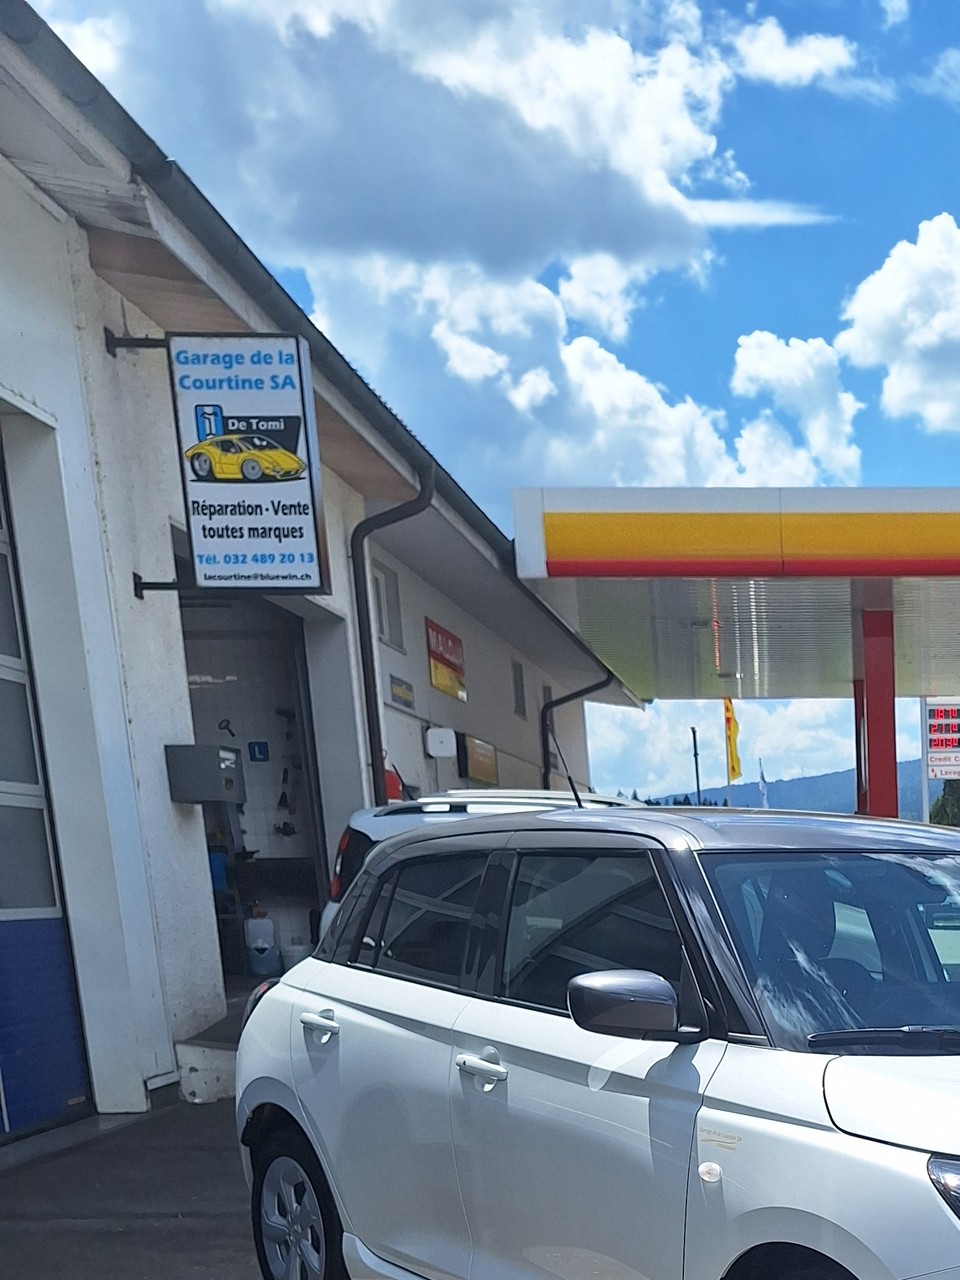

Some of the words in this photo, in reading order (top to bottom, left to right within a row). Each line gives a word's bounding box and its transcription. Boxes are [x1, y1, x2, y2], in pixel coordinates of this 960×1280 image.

[175, 349, 245, 370] Garage
[249, 350, 274, 366] de
[278, 349, 295, 366] la
[178, 374, 265, 391] Courtine
[269, 374, 297, 391] SA
[227, 419, 247, 430] De
[249, 418, 285, 430] Tomi
[191, 499, 263, 521] Réparation
[270, 499, 310, 516] Vente
[201, 524, 245, 540] toutes
[247, 526, 305, 544] marques
[223, 553, 248, 565] 032
[251, 553, 276, 564] 489
[279, 553, 296, 564] 20
[300, 552, 315, 564] 13
